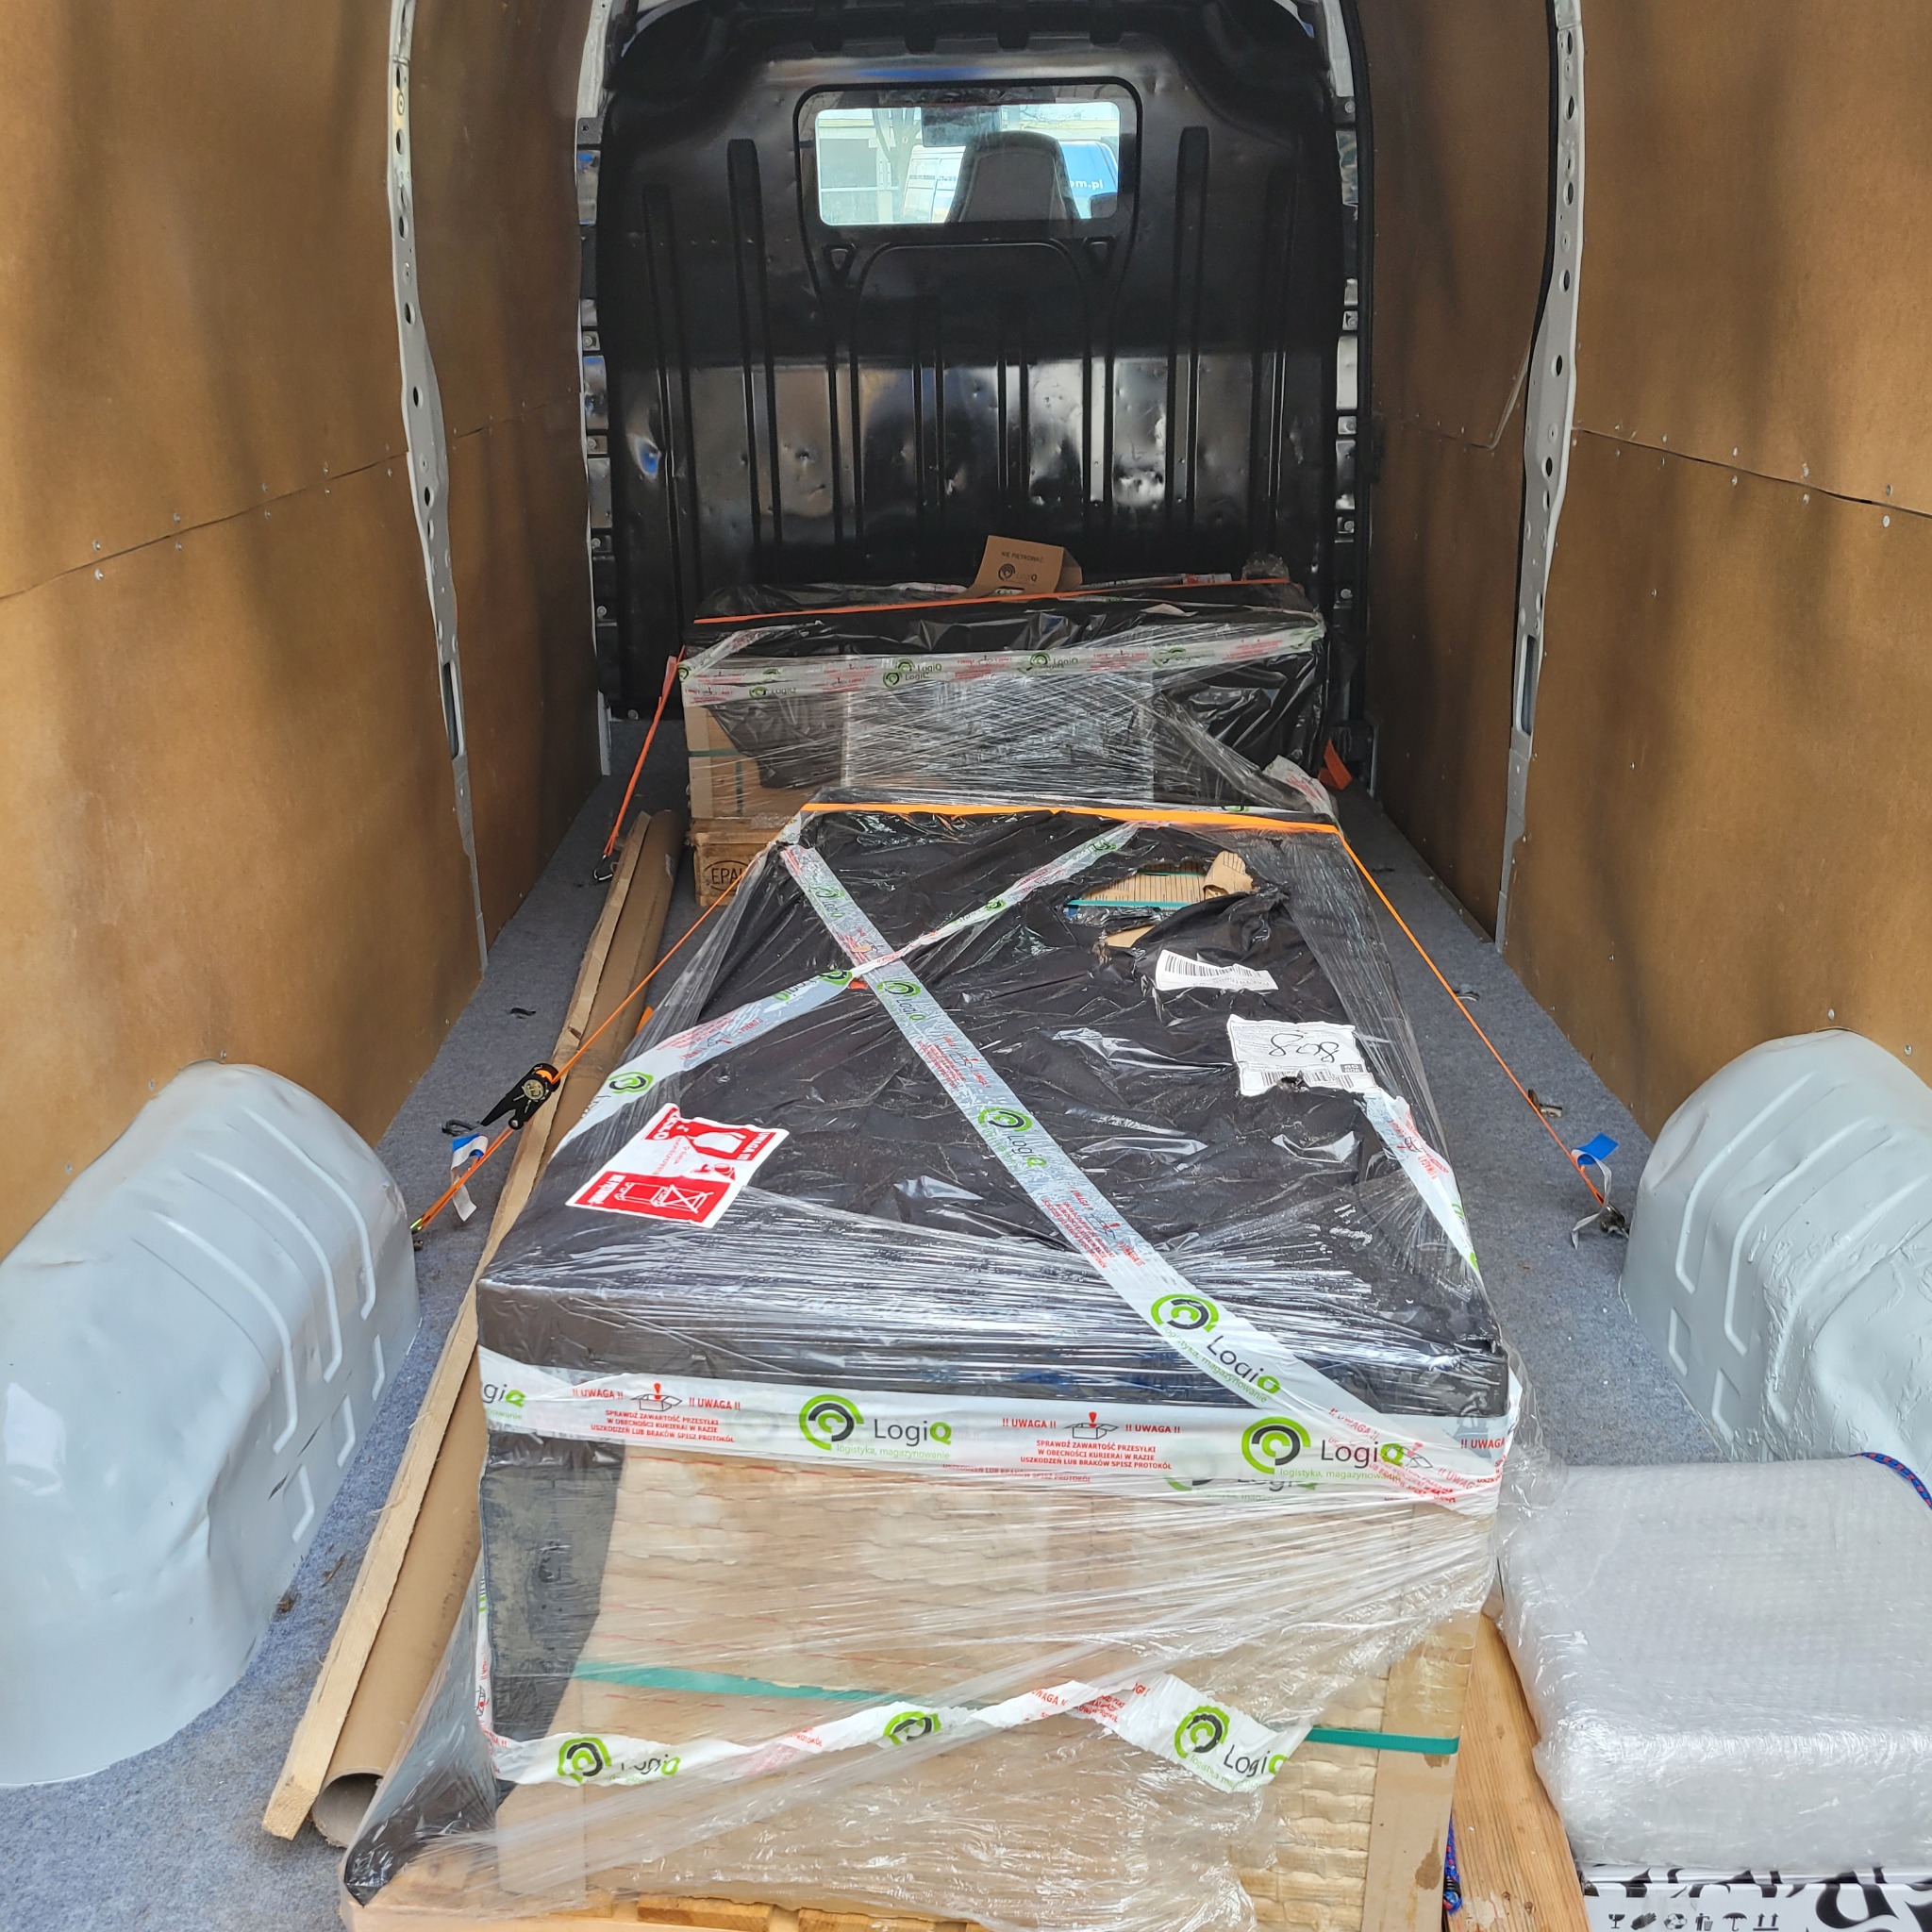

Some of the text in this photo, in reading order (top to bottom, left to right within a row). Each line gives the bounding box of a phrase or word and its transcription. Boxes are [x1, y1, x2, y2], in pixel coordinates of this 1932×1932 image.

[918, 663, 941, 673] LogiQ
[741, 1132, 770, 1155] UWAGA
[1007, 1135, 1047, 1168] LogiQ
[1207, 1335, 1281, 1394] LogiQ
[483, 1384, 525, 1407] giQ
[581, 1390, 614, 1399] UWAGA
[697, 1398, 731, 1409] UWAGA
[1011, 1419, 1047, 1429] UWAGA
[1135, 1424, 1171, 1434] UWAGA
[632, 1427, 645, 1436] LUB
[874, 1419, 952, 1447] LogiQ
[1037, 1439, 1072, 1449] SPRAWDŹ
[1073, 1440, 1116, 1451] ZAWARTOŚĆ
[1461, 1439, 1468, 1448] !!
[837, 1443, 950, 1460] logistyka, magazynowanie
[1046, 1447, 1087, 1457] OBECNOŚCI
[1321, 1440, 1404, 1469] LogiQ
[1020, 1456, 1062, 1465] USZKODZEŃ
[1078, 1458, 1109, 1467] BRAKÓW
[1134, 1461, 1172, 1470] PROTOKÓŁ
[1280, 1468, 1324, 1481] logistyka,
[1446, 1472, 1475, 1489] UWAG
